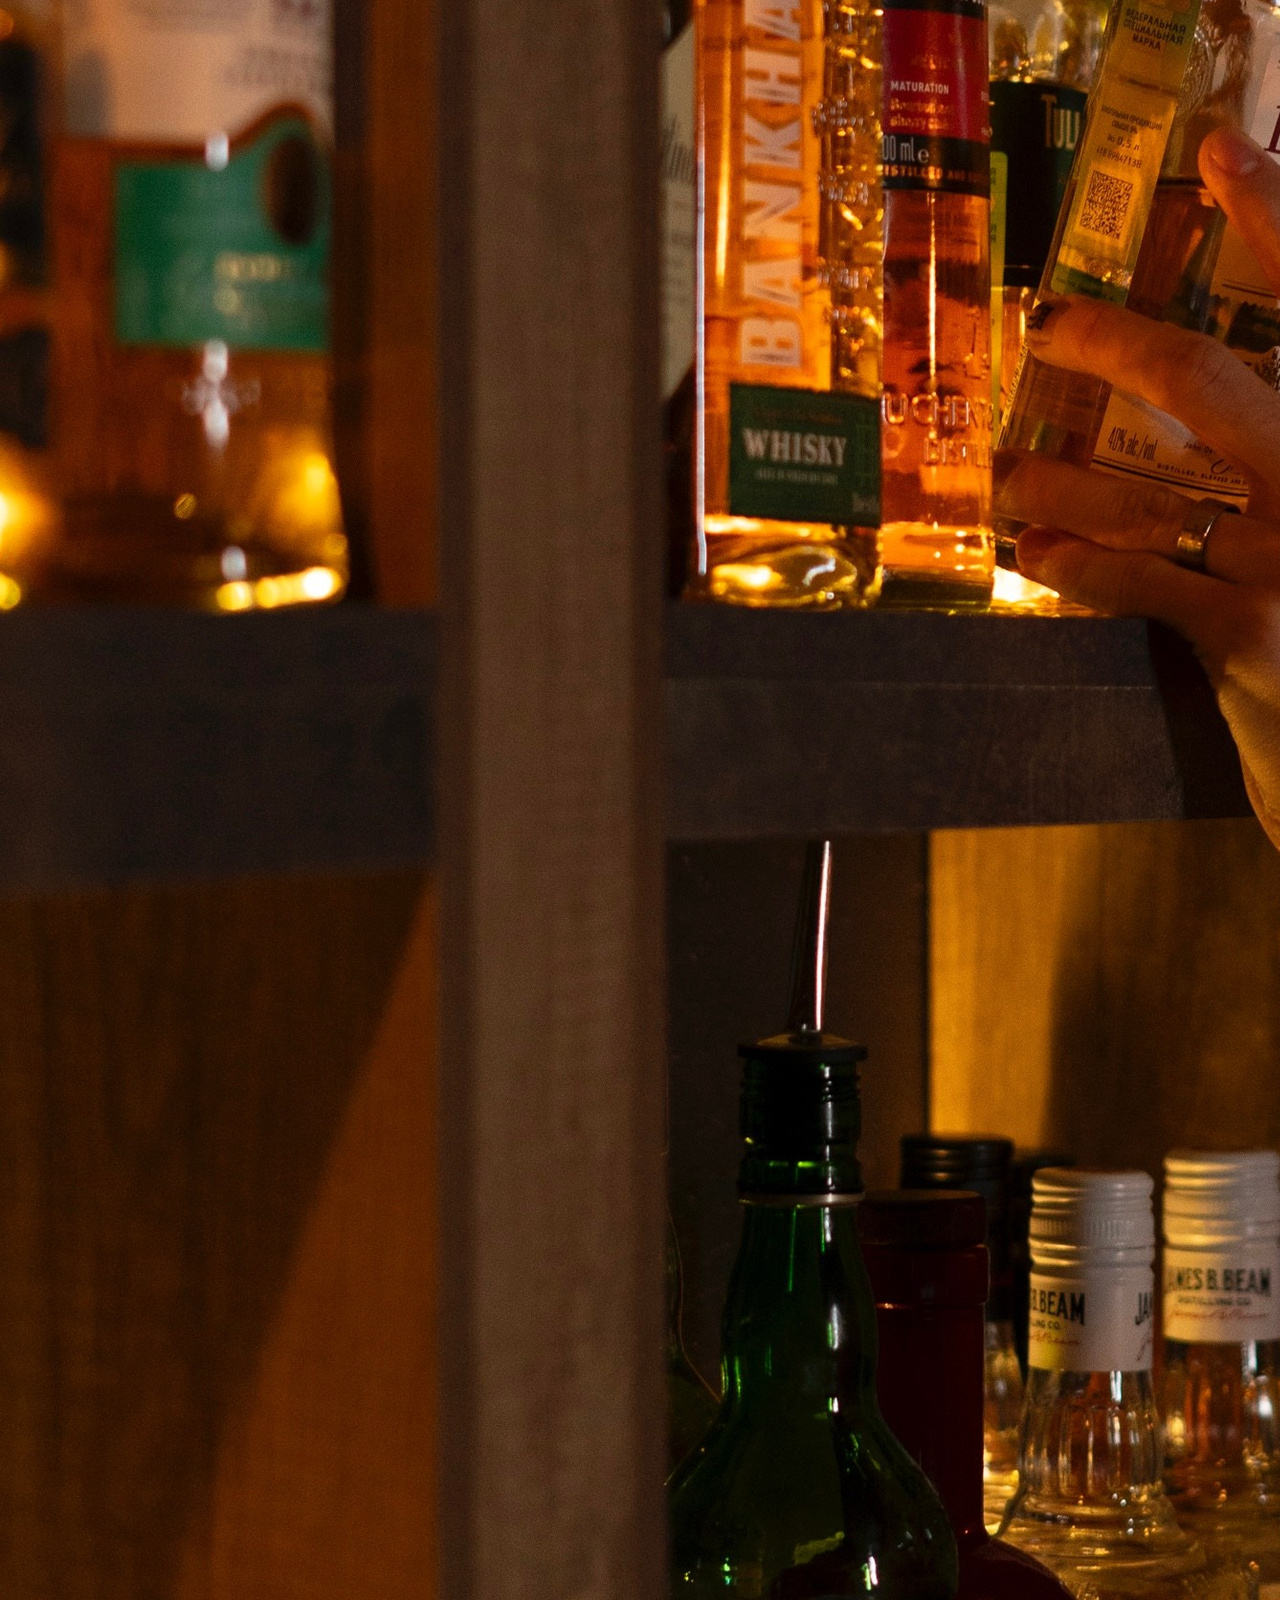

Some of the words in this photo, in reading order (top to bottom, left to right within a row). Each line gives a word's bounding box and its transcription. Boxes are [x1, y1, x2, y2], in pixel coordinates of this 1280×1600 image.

[1123, 18, 1184, 45] СПЕЦИАЛЬНАЯ
[1125, 7, 1187, 33] ФЕДЕРАЛЬНАЯ
[1132, 33, 1161, 50] МАРКА
[889, 80, 950, 95] MATURATION
[900, 137, 915, 162] ml
[1117, 136, 1132, 149] 0,5
[742, 427, 847, 468] WHISKY
[1107, 426, 1128, 454] 40%
[1039, 1290, 1085, 1326] BEAM
